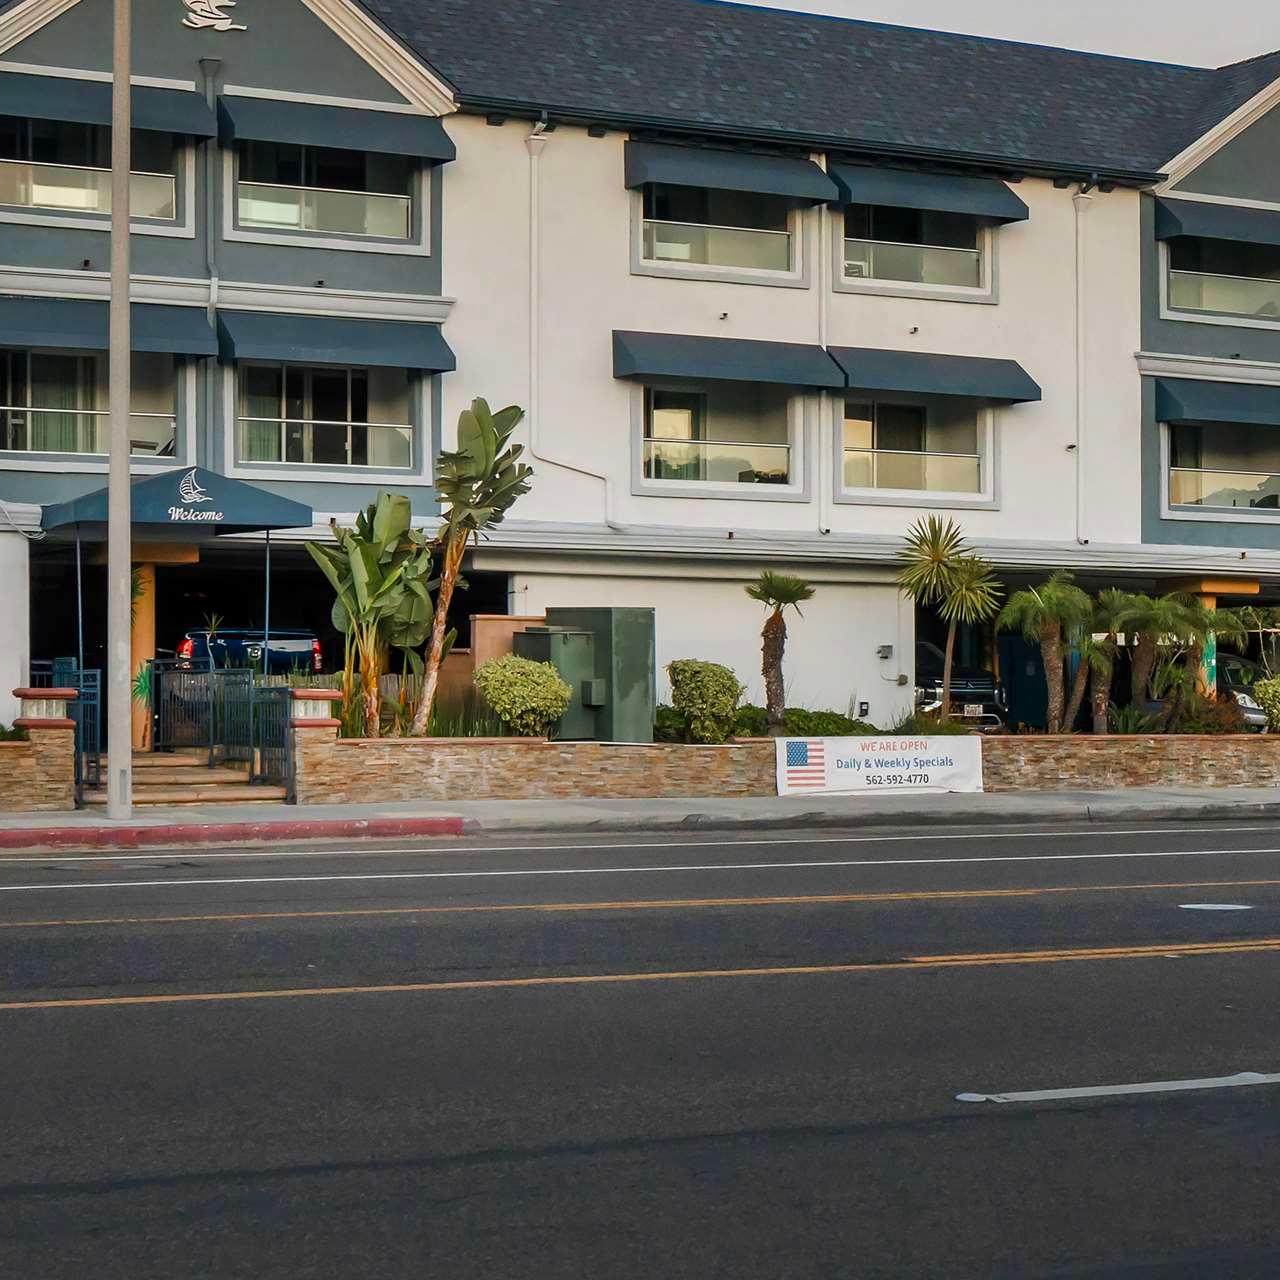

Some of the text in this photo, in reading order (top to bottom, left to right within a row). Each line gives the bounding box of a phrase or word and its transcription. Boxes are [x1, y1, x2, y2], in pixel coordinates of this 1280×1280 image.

[167, 506, 225, 521] Welcome
[860, 740, 928, 752] WE ARE OPEN
[836, 755, 954, 772] Daily & Weekly Specials
[865, 773, 930, 786] 562-592-4770
